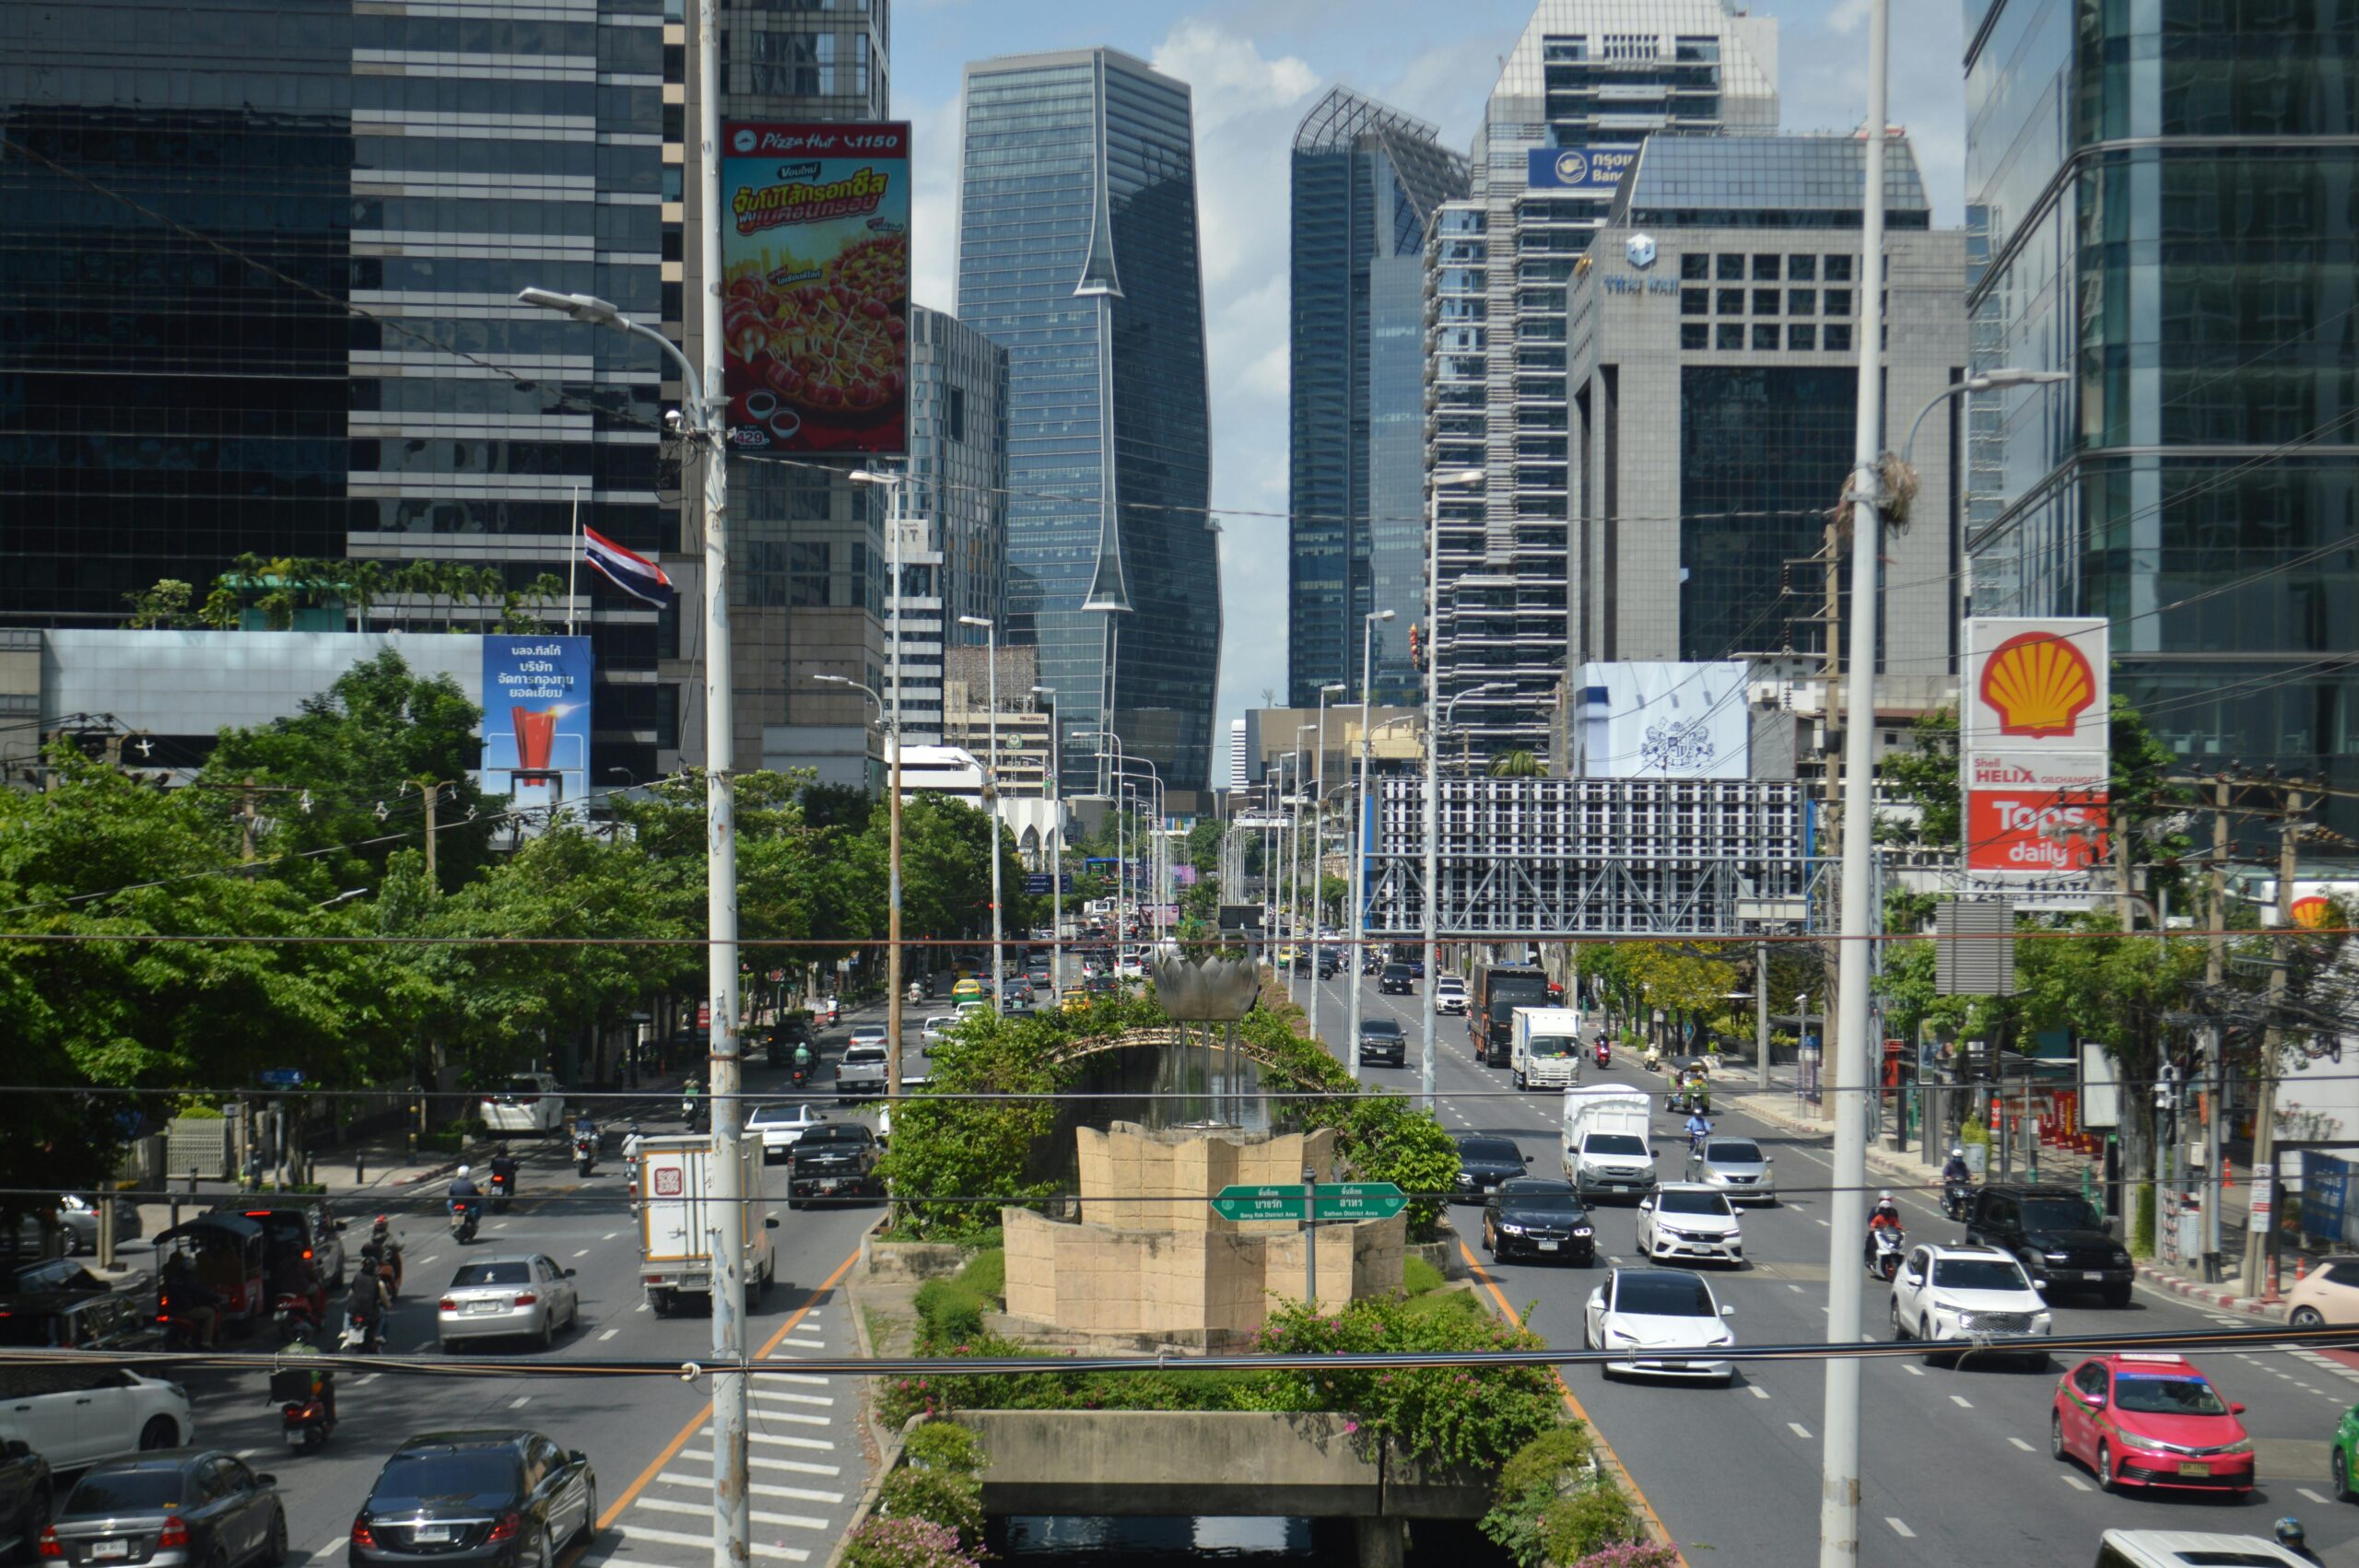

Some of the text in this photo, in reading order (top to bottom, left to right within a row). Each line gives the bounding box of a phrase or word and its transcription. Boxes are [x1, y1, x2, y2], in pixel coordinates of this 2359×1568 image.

[761, 133, 898, 149] Pizza Hut 1150
[511, 644, 562, 656] บลจ.ทิสโก้
[520, 661, 553, 673] บริษัท
[498, 673, 574, 687] จัดการกองทุน
[509, 685, 562, 698] ยอดเยี่ยม
[1975, 757, 2001, 767] Shell
[1976, 768, 2036, 783] HELIX
[1991, 801, 2085, 839] Tops
[2009, 841, 2068, 868] daily
[1254, 1199, 1283, 1210] บางรัก
[1339, 1198, 1363, 1207] สาทร
